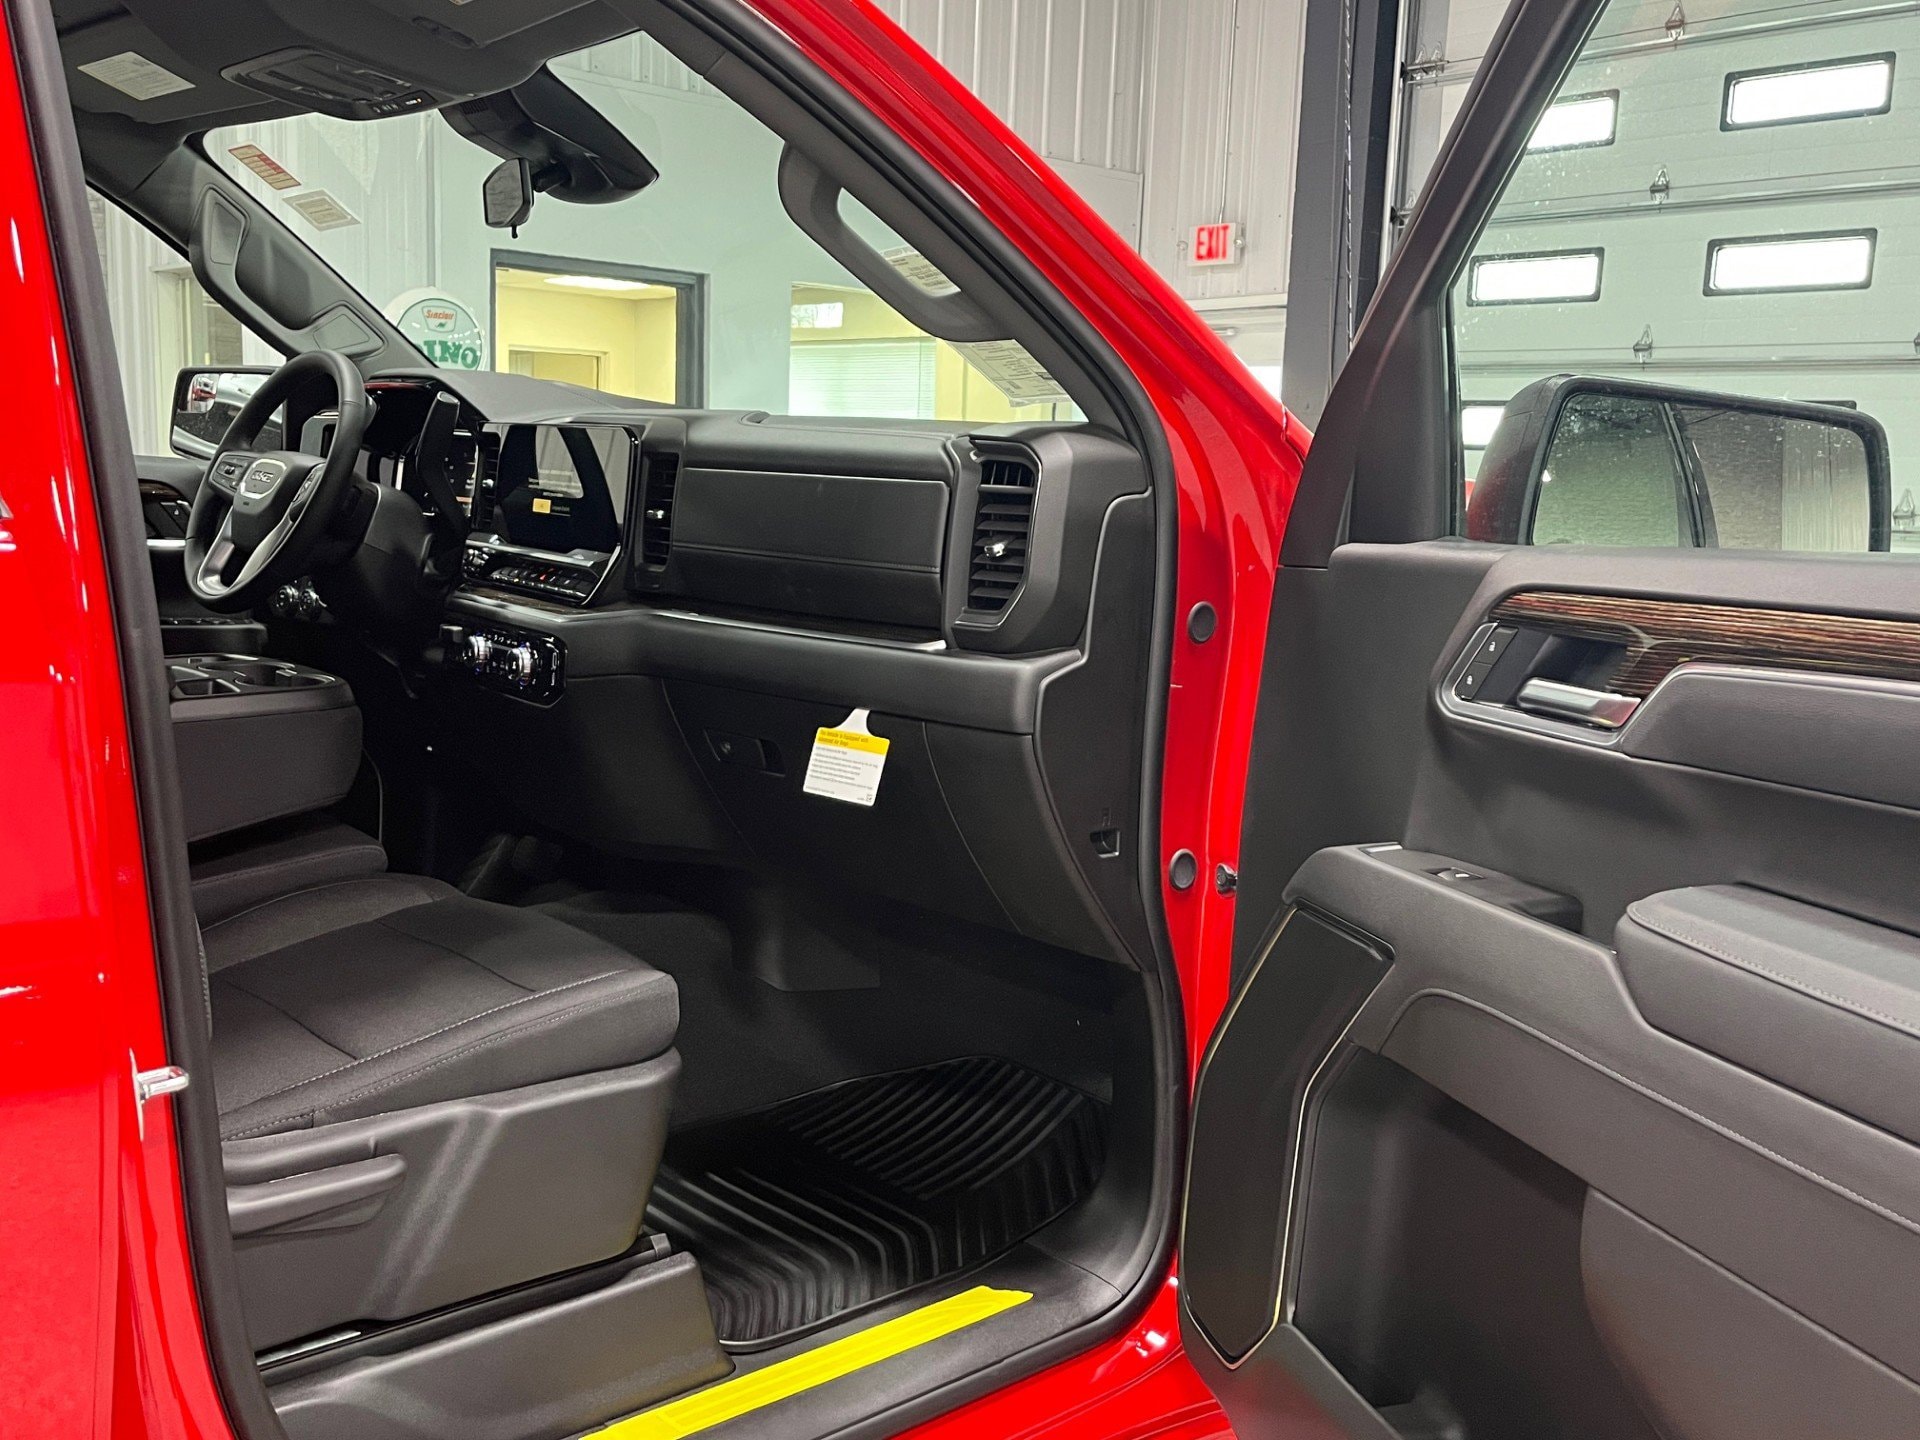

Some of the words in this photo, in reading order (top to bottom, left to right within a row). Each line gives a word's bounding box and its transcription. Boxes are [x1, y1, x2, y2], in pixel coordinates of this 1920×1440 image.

[1196, 225, 1229, 260] EXIT
[425, 309, 455, 320] Sinclair
[414, 339, 479, 369] INO
